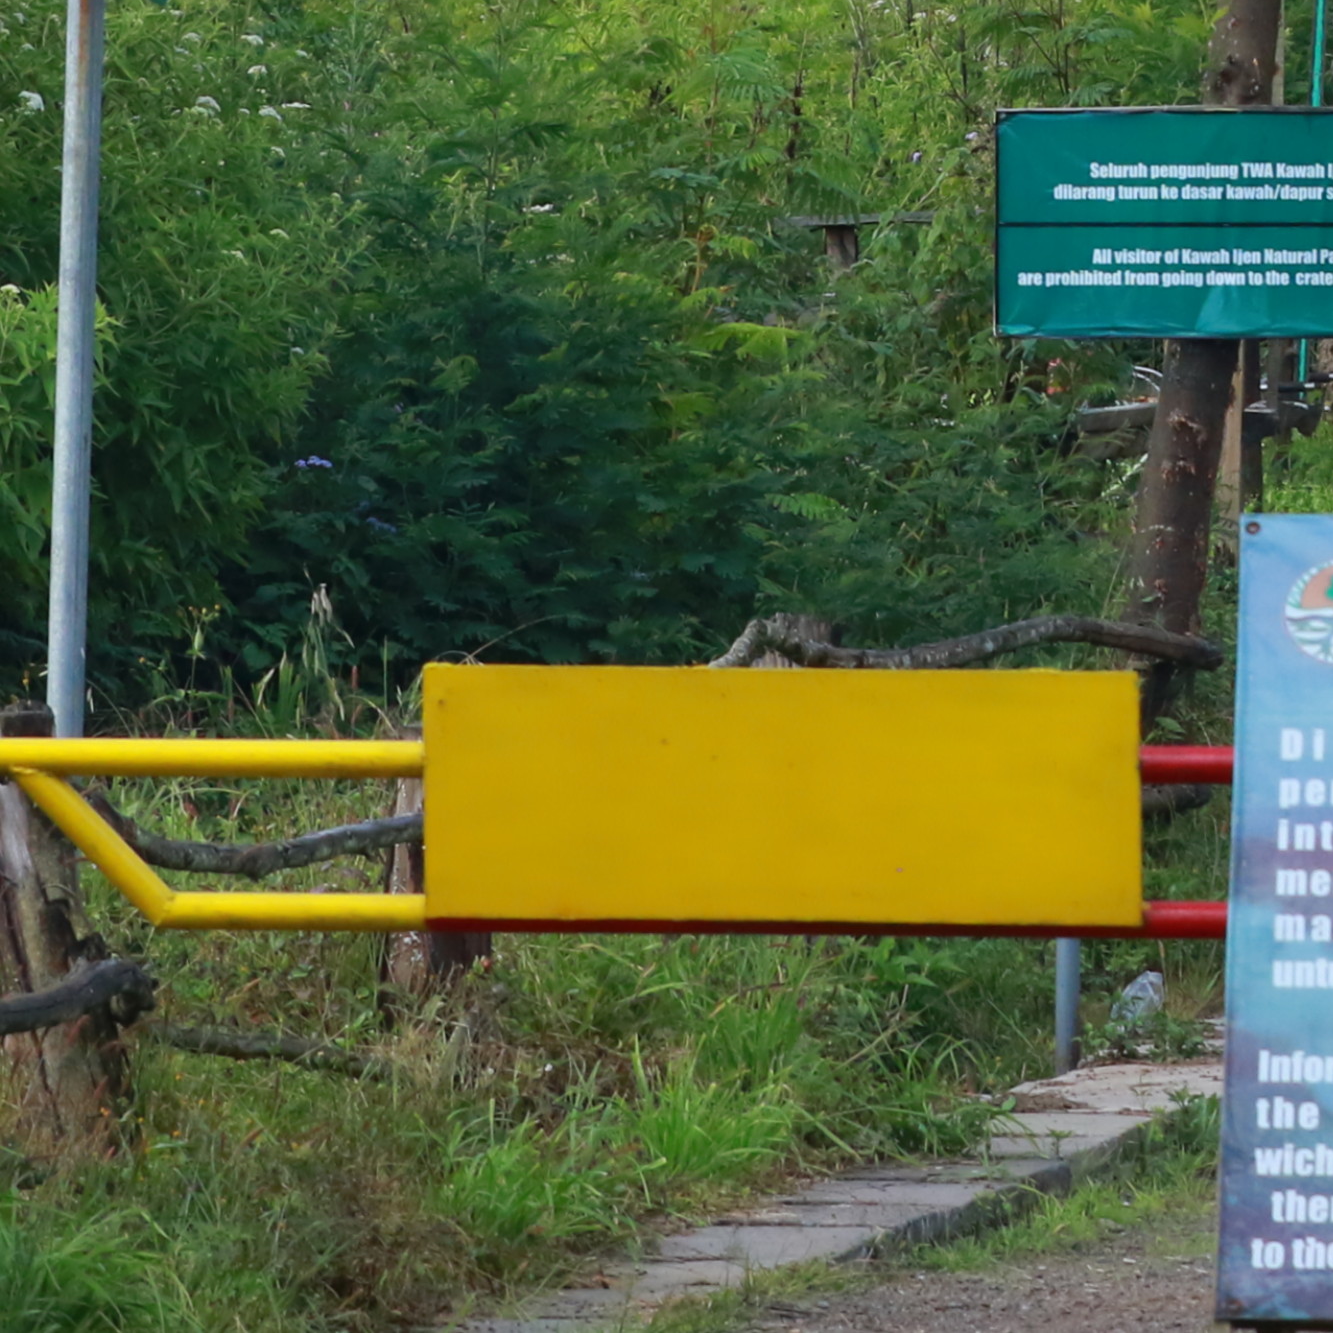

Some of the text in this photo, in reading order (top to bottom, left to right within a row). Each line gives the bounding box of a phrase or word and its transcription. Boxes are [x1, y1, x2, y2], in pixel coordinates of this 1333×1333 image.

[1089, 162, 1149, 178] Seluruh
[1149, 163, 1240, 179] pengunjung
[1241, 163, 1275, 178] TWA
[1275, 163, 1326, 179] Kawah
[1053, 184, 1117, 201] dilarang
[1117, 185, 1159, 199] turun
[1159, 184, 1180, 200] ke
[1180, 184, 1224, 200] dasar
[1225, 184, 1325, 201] kawah/dapur
[1092, 248, 1112, 264] All
[1114, 248, 1162, 264] visitor
[1164, 249, 1180, 264] of
[1181, 248, 1230, 264] Kawah
[1263, 248, 1318, 264] Natural
[1018, 272, 1043, 286] are
[1045, 270, 1122, 287] prohibited
[1124, 270, 1160, 286] from
[1161, 270, 1204, 287] going
[1206, 270, 1246, 286] down
[1248, 271, 1264, 286] to
[1265, 270, 1290, 286] the
[1279, 728, 1327, 760] Di
[1255, 1096, 1321, 1129] the
[1250, 1237, 1286, 1269] to
